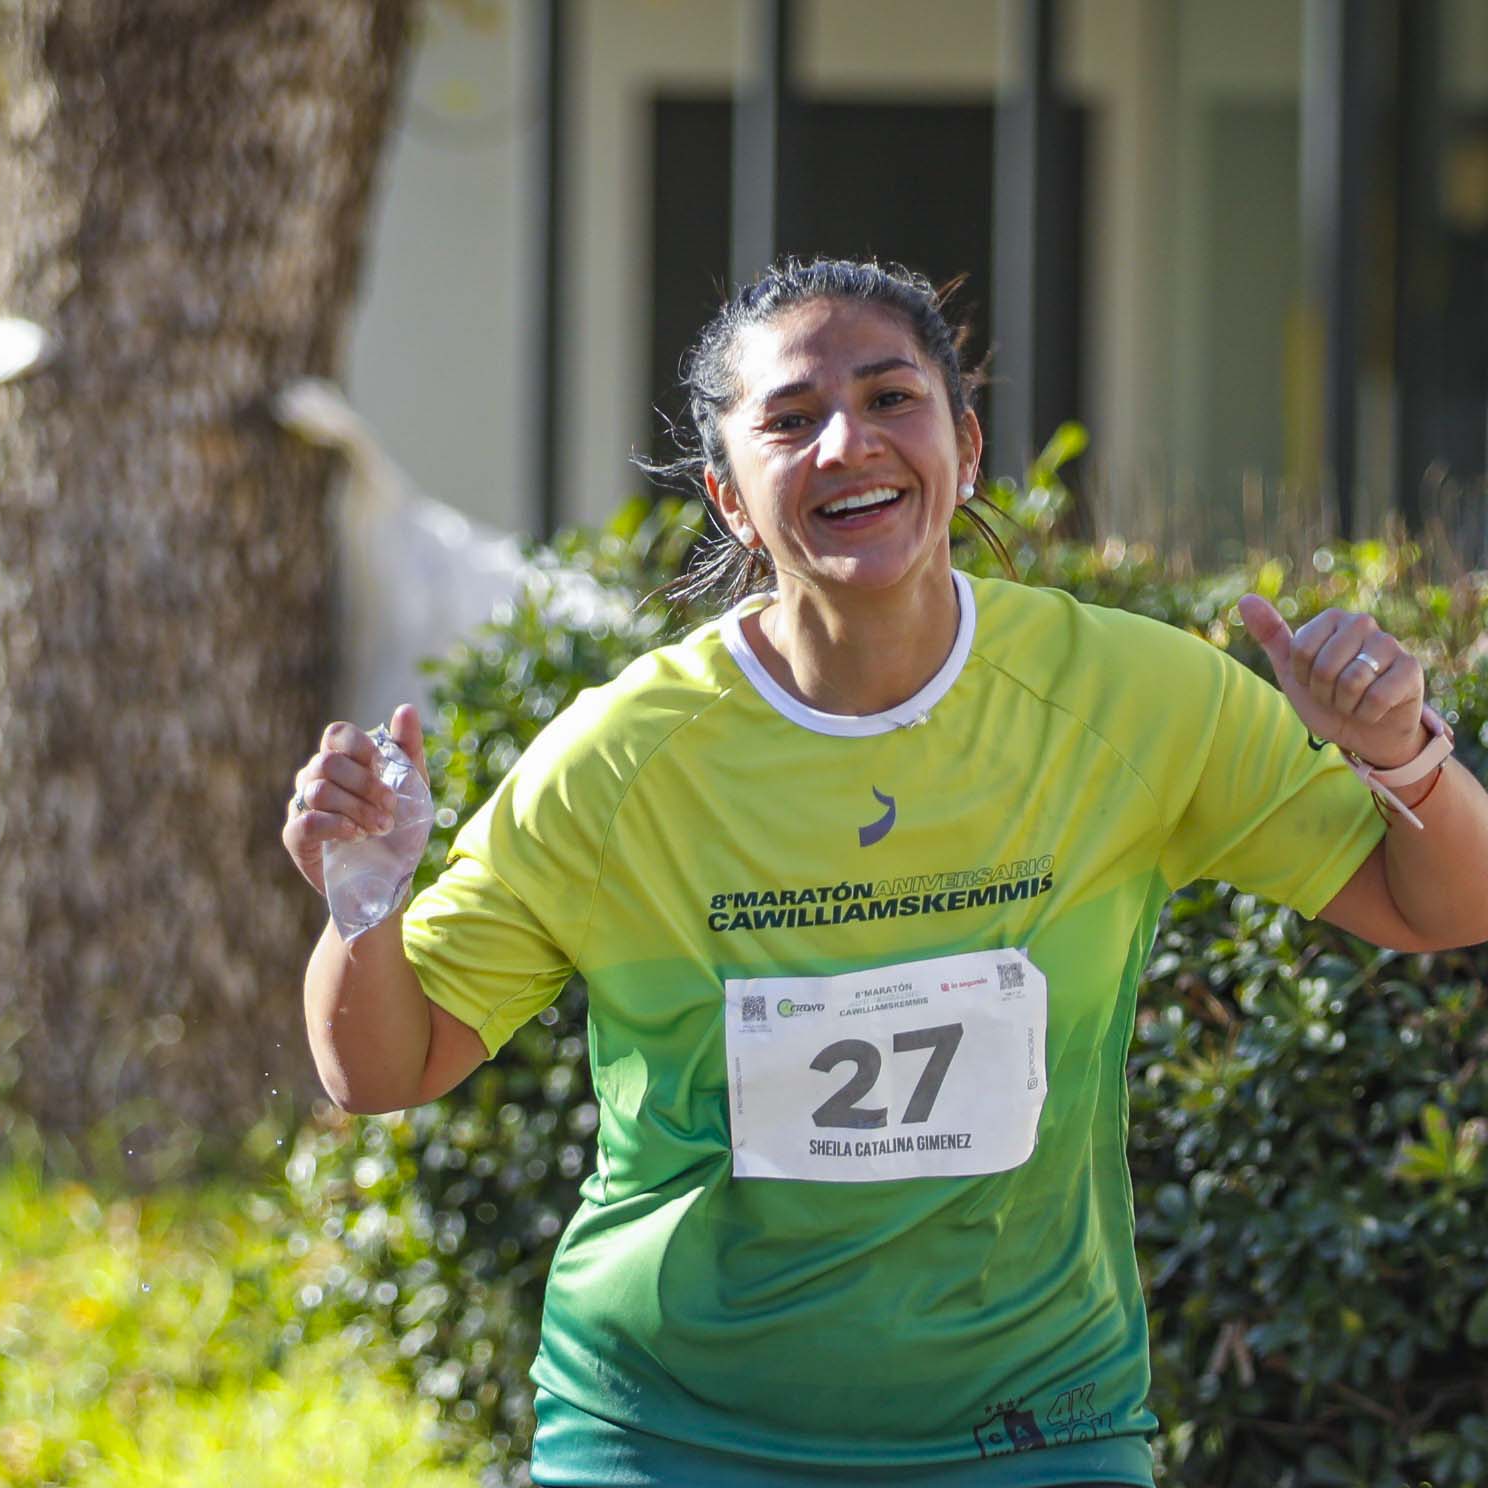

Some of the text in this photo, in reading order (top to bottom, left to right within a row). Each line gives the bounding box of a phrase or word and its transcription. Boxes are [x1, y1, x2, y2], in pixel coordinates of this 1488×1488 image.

[708, 871, 1053, 932] CAWILLIAMSKEMMIS
[809, 1022, 964, 1130] 27
[809, 1133, 972, 1157] SHEILA CATALINA GIMENEZ
